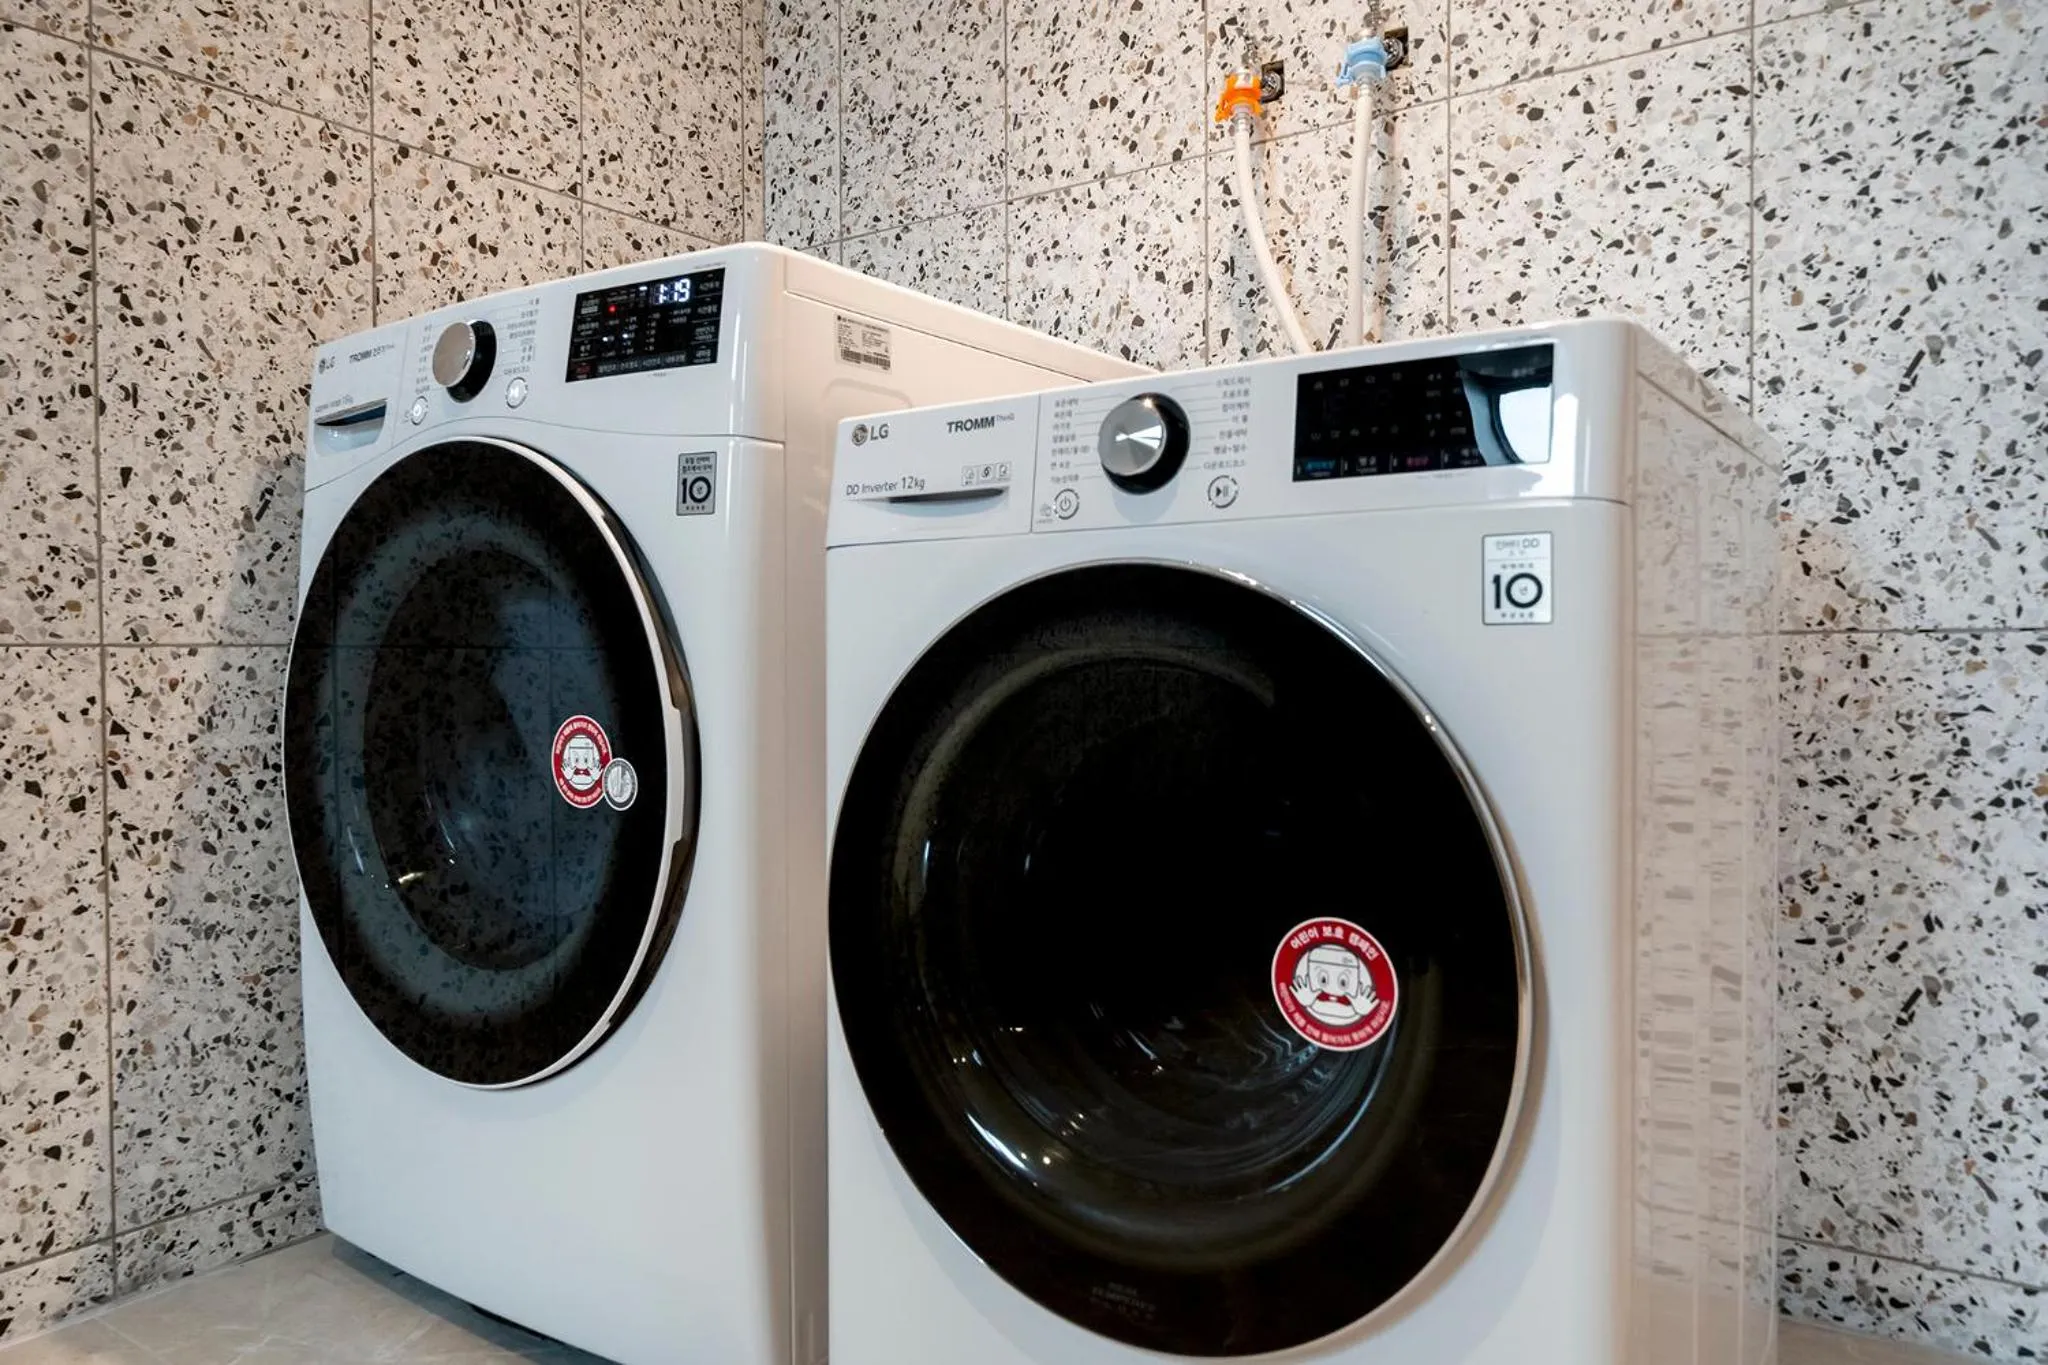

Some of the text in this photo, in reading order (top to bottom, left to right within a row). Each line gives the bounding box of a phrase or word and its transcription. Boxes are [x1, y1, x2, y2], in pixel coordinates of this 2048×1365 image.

[870, 423, 890, 441] LG
[946, 415, 995, 434] TROMM
[846, 475, 925, 496] DD Inverter 12kg
[1492, 572, 1543, 609] 10
[1290, 926, 1320, 949] 어린이
[1322, 925, 1344, 939] 보호
